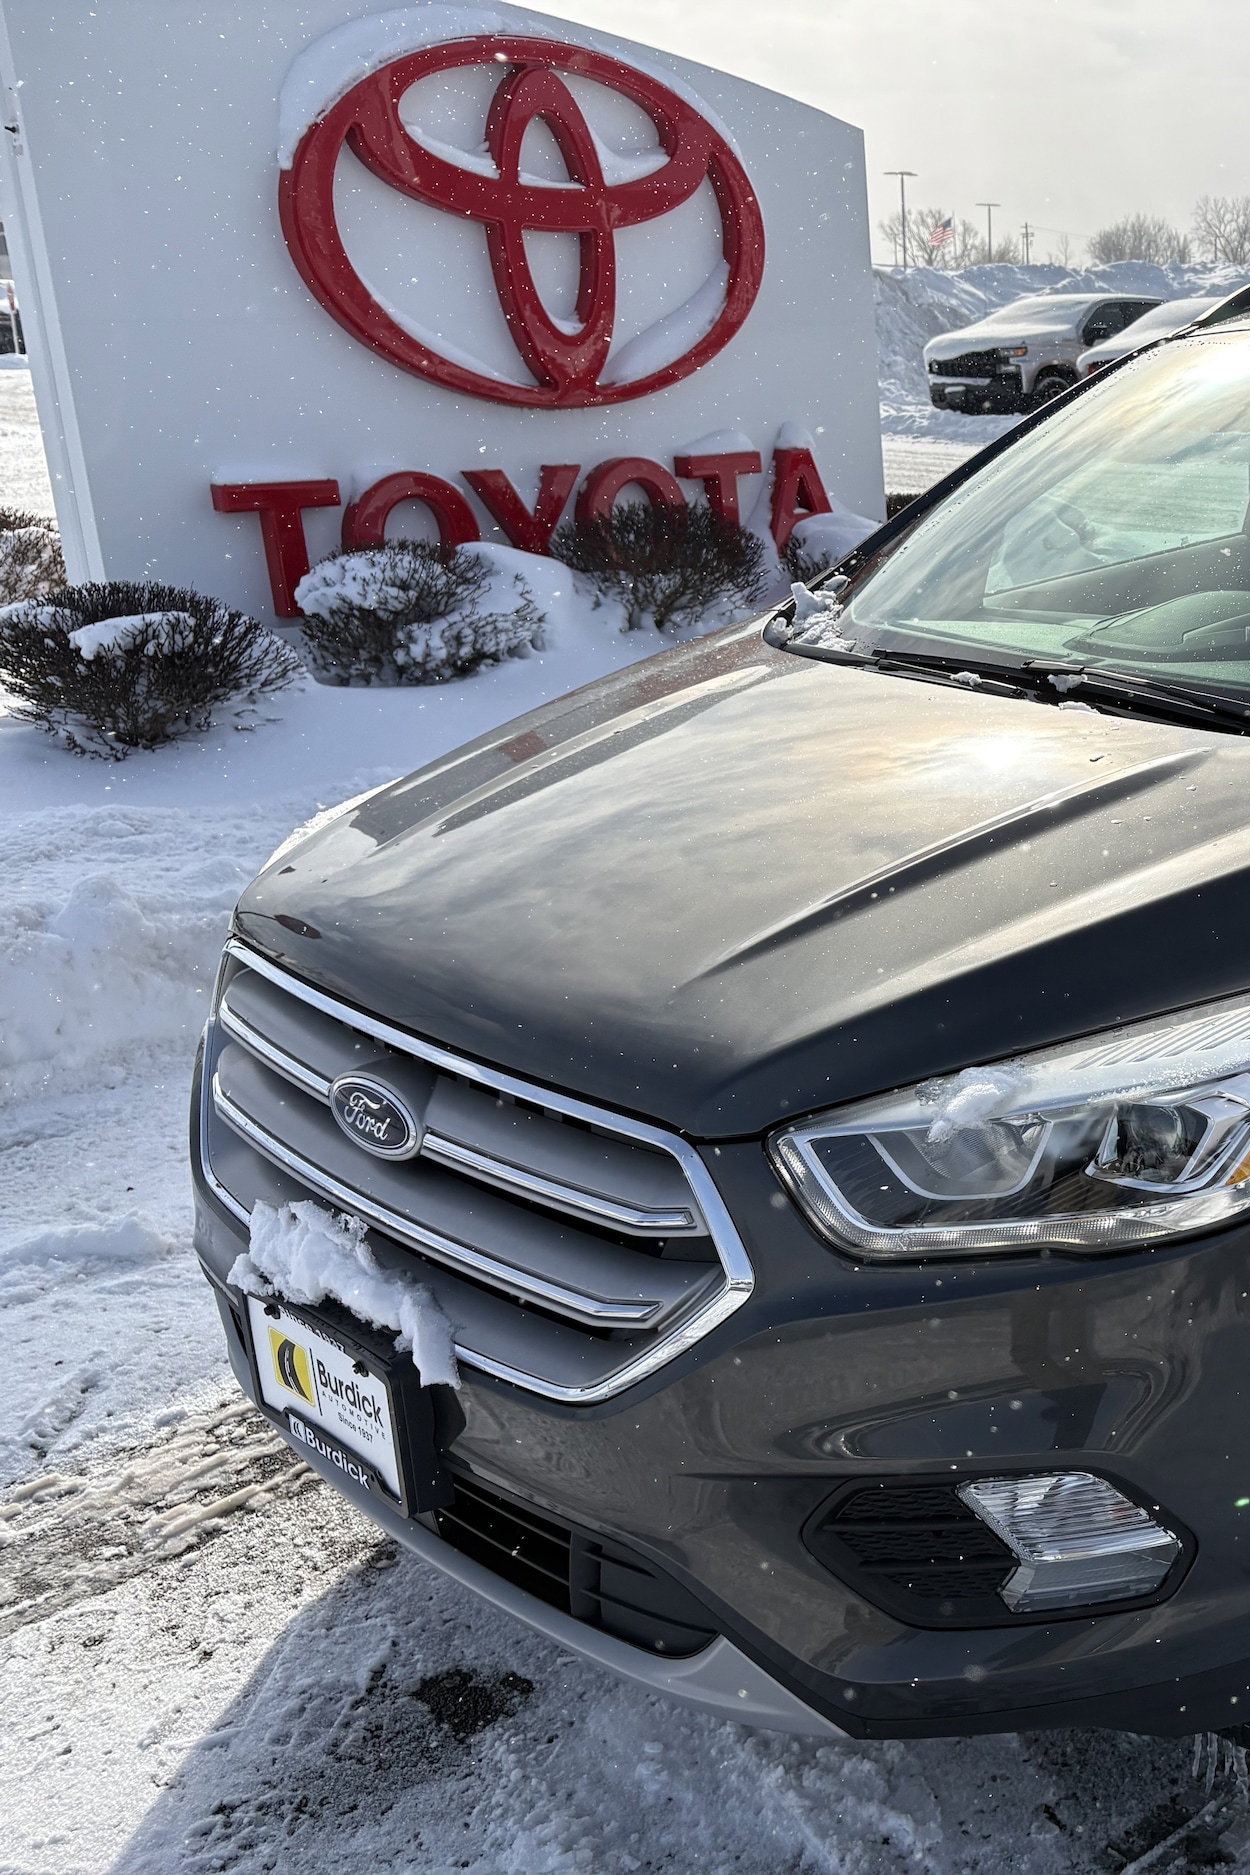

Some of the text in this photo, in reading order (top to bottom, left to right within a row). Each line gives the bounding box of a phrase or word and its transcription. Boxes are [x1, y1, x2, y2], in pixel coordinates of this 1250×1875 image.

[210, 447, 834, 618] TOYOTA
[344, 1091, 391, 1141] Ford
[316, 1358, 384, 1429] Burdick
[321, 1390, 386, 1440] AUTOMOTIVE
[337, 1411, 373, 1443] Since 1937
[305, 1426, 370, 1490] Burdick
